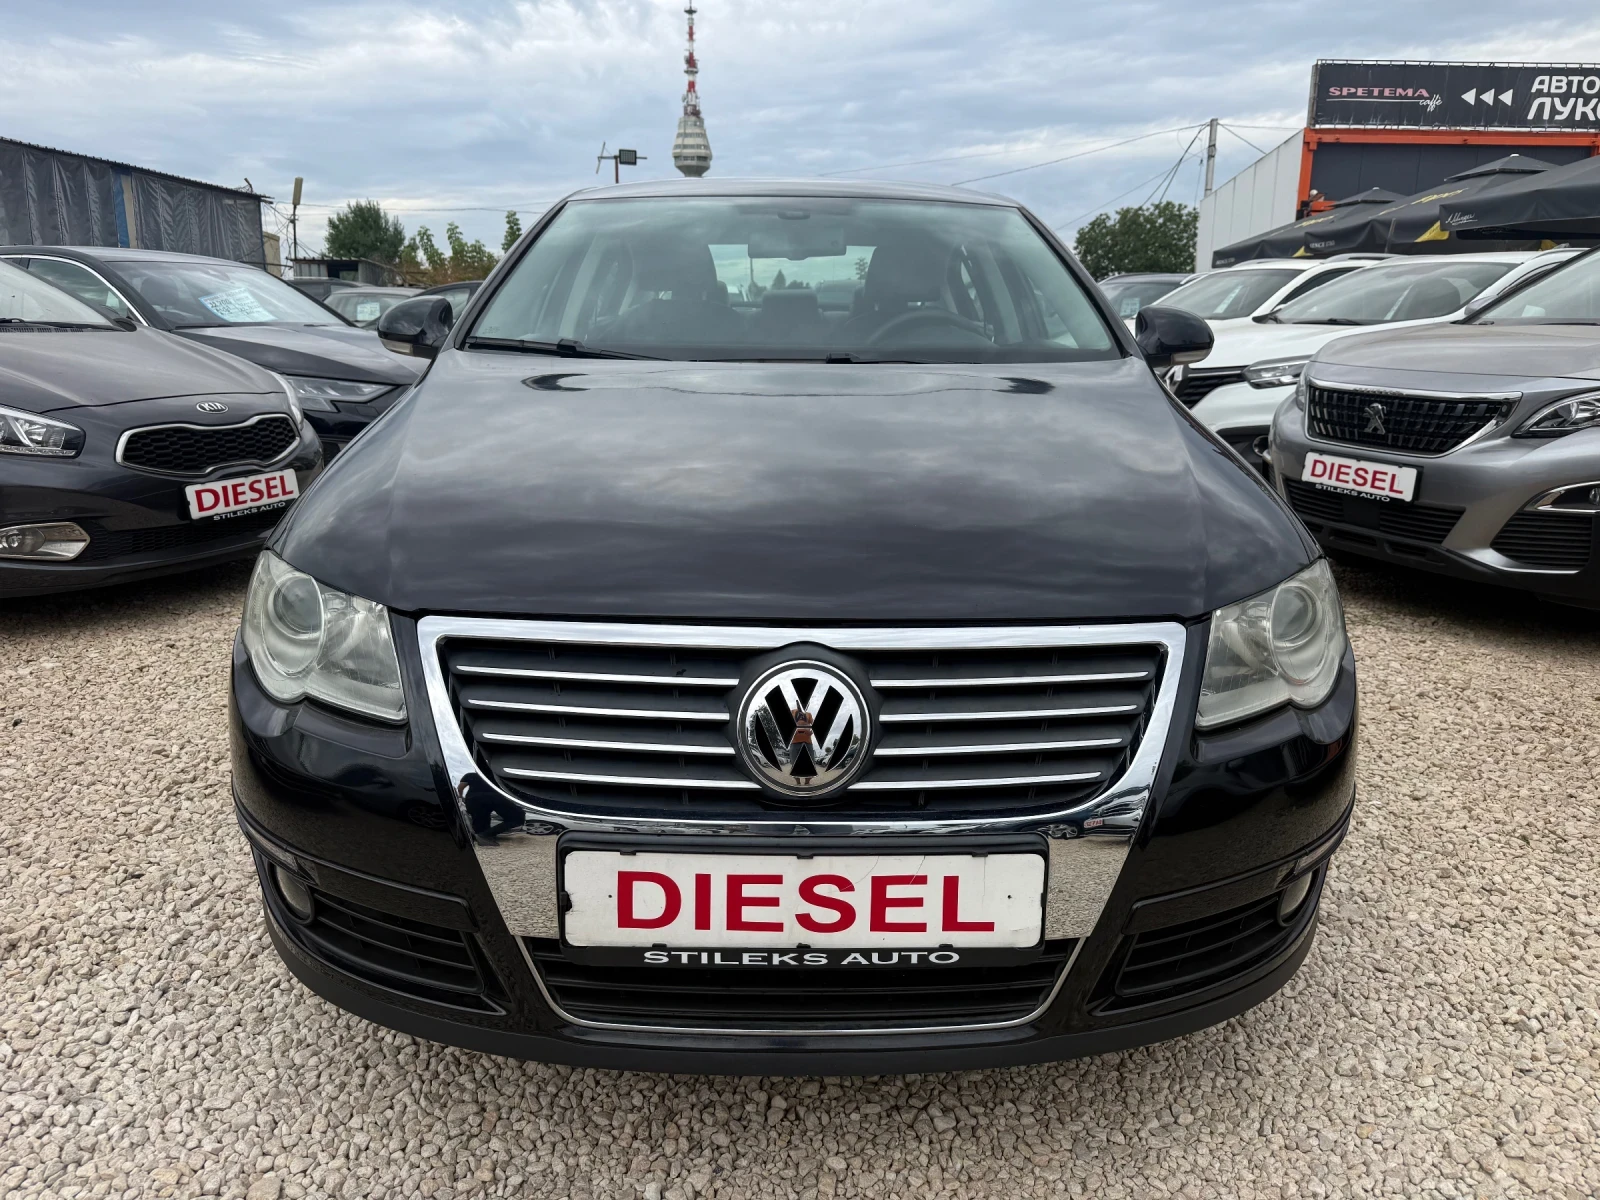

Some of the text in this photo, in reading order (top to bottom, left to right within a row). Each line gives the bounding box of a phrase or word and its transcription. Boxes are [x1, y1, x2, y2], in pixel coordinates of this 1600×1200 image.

[1328, 86, 1430, 97] SPETEMA
[1531, 75, 1600, 94] АВТО
[1527, 97, 1600, 121] ЛУК
[199, 402, 227, 411] KIA
[1310, 459, 1404, 494] DIESEL
[195, 475, 294, 512] DIESEL
[1315, 484, 1390, 502] STILEKS AUTO
[213, 501, 286, 520] STILEKS AUTO
[617, 871, 995, 933] DIESEL
[643, 950, 960, 965] STILEKS AUTO
